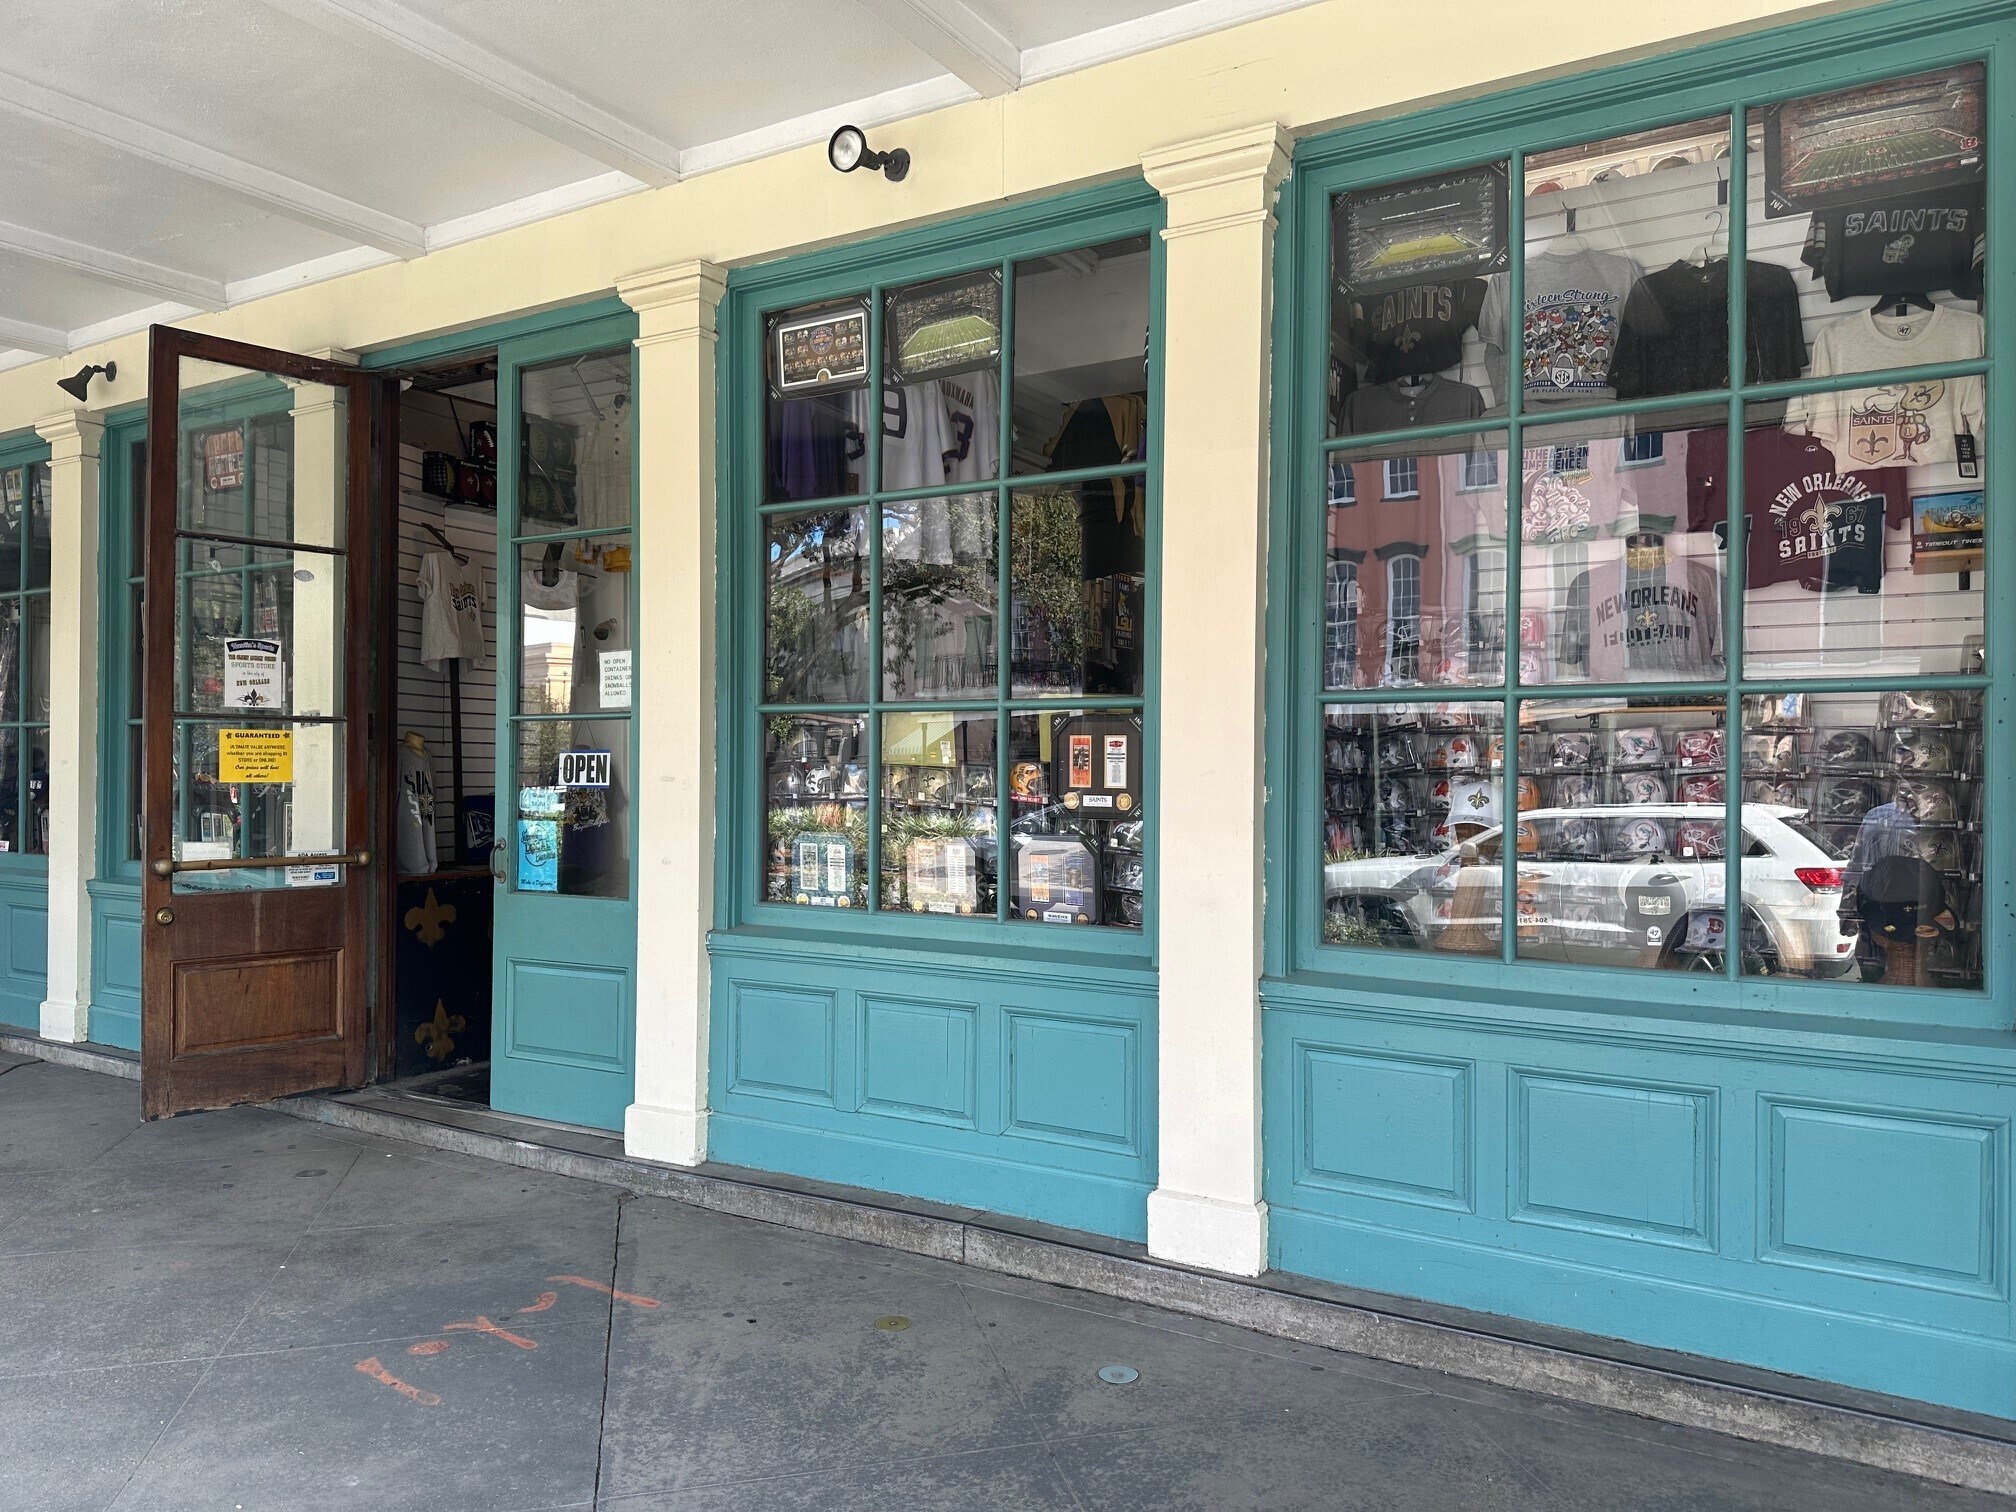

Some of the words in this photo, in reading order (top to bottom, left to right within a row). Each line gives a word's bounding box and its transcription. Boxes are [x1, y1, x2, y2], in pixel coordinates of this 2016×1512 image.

[1845, 209, 1968, 237] SAINTS
[1562, 289, 1617, 306] Strong
[1853, 415, 1894, 426] SAINTS
[1522, 458, 1582, 471] ONFERENCE
[1523, 446, 1589, 460] UTHEASTERN
[1768, 482, 1802, 517] NEW
[1802, 472, 1872, 502] ORLEANS
[1780, 518, 1801, 539] 19
[1845, 505, 1867, 524] 67
[1779, 523, 1865, 558] SAINTS
[1596, 591, 1627, 627] NEW
[1630, 586, 1698, 618] ORLEANS
[562, 754, 607, 783] OPEN
